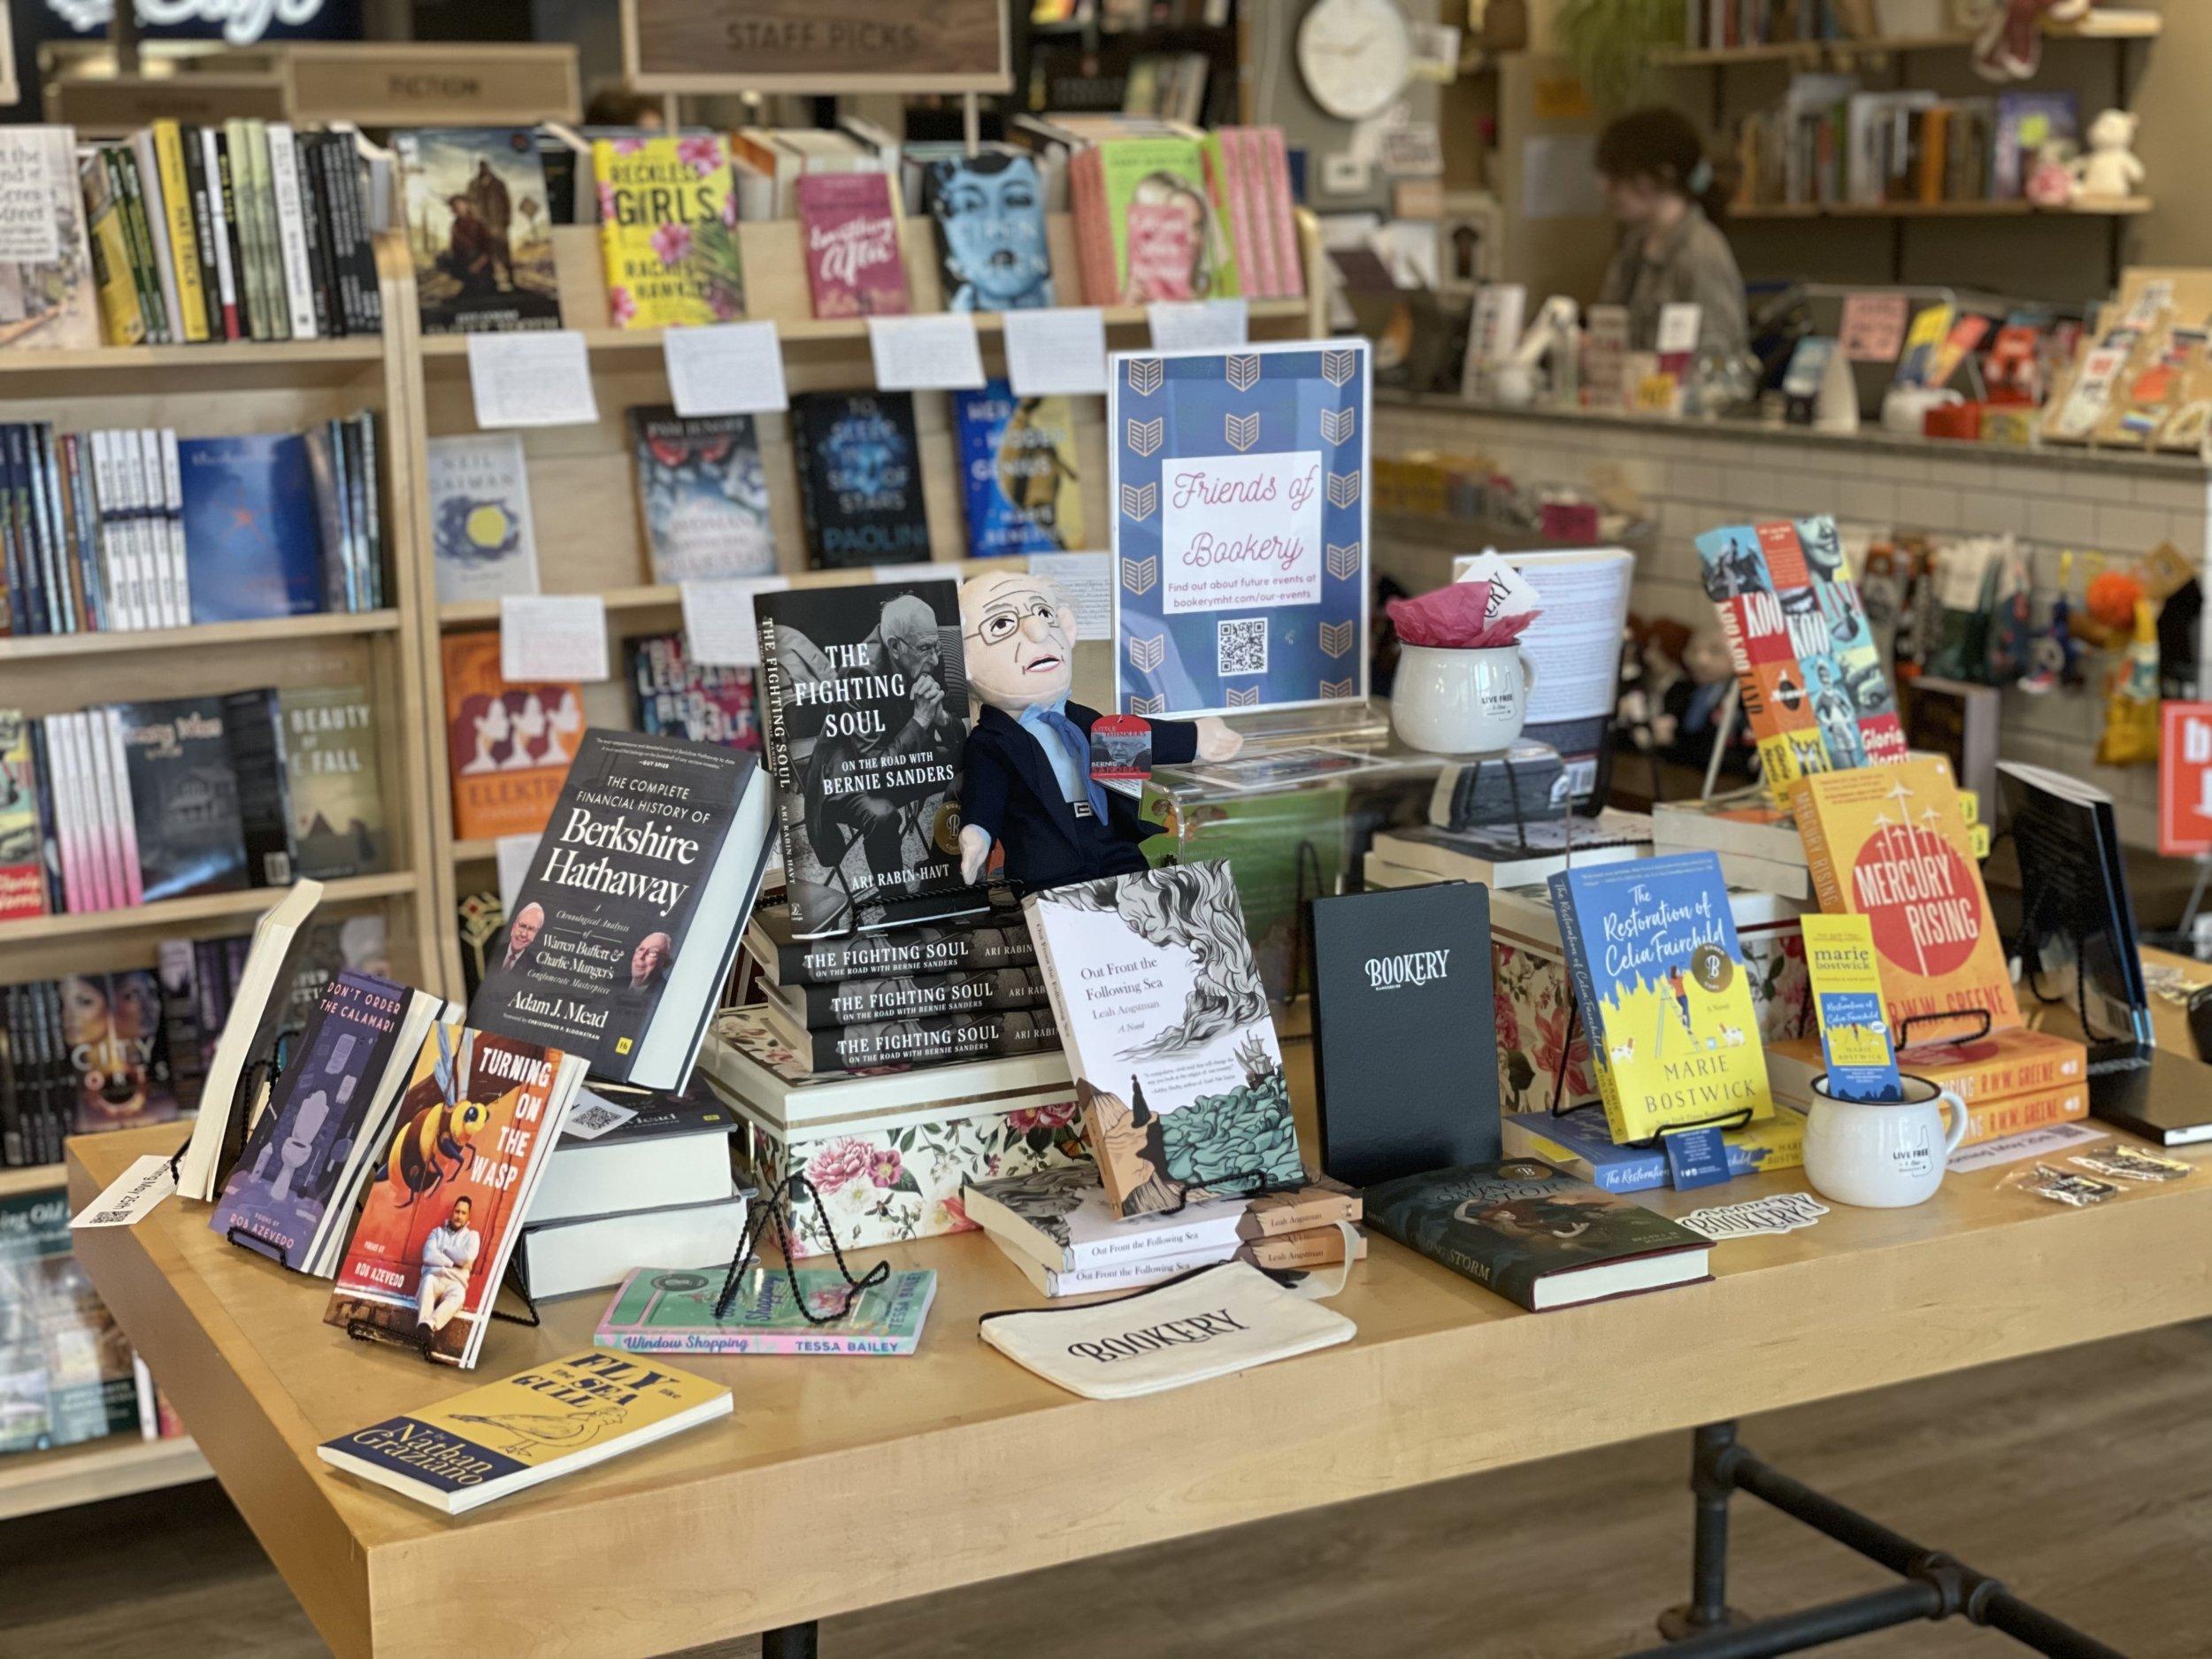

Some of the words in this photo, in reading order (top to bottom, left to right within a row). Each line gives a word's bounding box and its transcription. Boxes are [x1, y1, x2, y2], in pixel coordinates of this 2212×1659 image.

[726, 21, 816, 50] STAFF
[828, 22, 921, 51] PICKS
[614, 186, 716, 226] GIRLS
[1172, 472, 1277, 509] Friends
[1288, 464, 1319, 511] of
[1182, 532, 1304, 571] Bookery
[1168, 581, 1188, 592] Find
[1191, 580, 1207, 590] out
[1210, 579, 1239, 589] about
[1240, 577, 1270, 587] future
[1272, 575, 1303, 585] events
[1305, 574, 1317, 583] at
[1173, 592, 1311, 609] bookerymht.com/our-events
[1741, 592, 1785, 639] KOO
[762, 618, 776, 651] THE
[1785, 611, 1831, 660] KOO
[825, 643, 871, 668] THE
[768, 657, 785, 736] FIGHTING
[794, 673, 905, 706] FIGHTING
[1481, 696, 1498, 705] LIVE
[1499, 694, 1513, 703] FREE
[291, 704, 370, 733] BEAUTY
[826, 709, 887, 738] SOUL
[1862, 728, 1905, 749] Gloria
[311, 749, 362, 773] FALL
[776, 741, 790, 788] SOUL
[841, 759, 856, 772] ON
[858, 757, 878, 770] THE
[880, 754, 907, 768] ROAD
[909, 751, 933, 764] WITH
[607, 775, 626, 789] THE
[629, 779, 690, 800] COMPLETE
[823, 772, 881, 795] BERNIE
[886, 764, 955, 787] SANDERS
[576, 790, 634, 810] FINANCIAL
[637, 800, 689, 819] HISTORY
[691, 810, 710, 824] OF
[559, 807, 699, 864] Berkshire
[1794, 790, 1825, 854] MERCURY
[1814, 856, 1839, 906] RISING
[539, 849, 689, 917] Hathaway
[851, 874, 874, 890] ARI
[878, 864, 950, 887] RABIN-HAVT
[1854, 854, 1954, 908] MERCURY
[1628, 884, 1652, 905] The
[556, 910, 600, 926] Chronological
[601, 918, 630, 932] Analysis
[1603, 900, 1694, 941] Restoration
[1695, 891, 1712, 918] of
[1905, 897, 1979, 947] RISING
[543, 934, 575, 953] Warren
[576, 941, 608, 961] Buffett
[610, 949, 625, 963] &
[582, 930, 591, 939] of
[1605, 944, 1655, 977] Celia
[1650, 918, 1726, 963] Fairchild
[536, 950, 569, 971] Charlie
[569, 958, 615, 979] Munger's
[804, 951, 836, 969] THE
[842, 944, 920, 965] FIGHTING
[926, 941, 969, 958] SOUL
[985, 948, 1002, 956] ARI
[1814, 946, 1870, 961] marie
[1815, 959, 1870, 970] bostwick
[526, 969, 571, 987] Conglomerate
[572, 978, 611, 995] Masterpiece
[815, 969, 827, 978] ON
[829, 967, 845, 976] THE
[847, 965, 868, 975] ROAD
[871, 964, 890, 973] WITH
[893, 962, 921, 972] BERNIE
[923, 958, 958, 969] SANDERS
[1080, 967, 1105, 979] Out
[1106, 960, 1138, 975] Front
[1140, 956, 1158, 968] the
[1364, 949, 1450, 987] BOOKERY
[326, 982, 362, 1002] DON'T
[365, 994, 402, 1015] ORDER
[832, 994, 864, 1011] THE
[870, 987, 946, 1009] FIGHTING
[951, 982, 994, 999] SOUL
[1086, 981, 1142, 1001] Following
[1143, 977, 1164, 990] Sea
[1946, 985, 2008, 1020] GREENE
[319, 999, 339, 1014] THE
[341, 1006, 396, 1033] CALAMARI
[508, 990, 550, 1016] Adam
[549, 1000, 561, 1017] J.
[563, 1002, 609, 1028] Mead
[856, 1011, 872, 1020] THE
[873, 1009, 895, 1018] ROAD
[896, 1007, 917, 1017] WITH
[918, 1003, 947, 1014] BERNIE
[949, 1000, 983, 1010] SANDERS
[1092, 1008, 1116, 1019] Leah
[1118, 1001, 1160, 1015] Angstman
[527, 1018, 560, 1032] CHRISTOPHER
[565, 1027, 600, 1041] BLOOMSTRAN
[837, 1036, 870, 1054] THE
[875, 1031, 951, 1051] FIGHTING
[956, 1025, 999, 1042] SOUL
[1125, 1021, 1145, 1031] Novel
[71, 1036, 156, 1071] CITY
[479, 1048, 553, 1087] TURNING
[1663, 1054, 1730, 1081] MARIE
[2017, 1062, 2055, 1087] GREENE
[515, 1093, 542, 1123] ON
[1644, 1079, 1756, 1113] BOSTWICK
[496, 1125, 531, 1158] THE
[1893, 1150, 1911, 1161] LIVE
[1911, 1148, 1930, 1157] FREE
[471, 1156, 519, 1191] WASP
[1603, 1169, 1620, 1187] The
[1622, 1164, 1670, 1184] Restoration
[229, 1213, 250, 1229] ROB
[251, 1223, 295, 1249] AZEVEDO
[1271, 1218, 1288, 1227] Leah
[1290, 1213, 1322, 1224] Angstman
[1682, 1205, 1813, 1234] BOOKERY
[1091, 1245, 1110, 1256] Out
[1110, 1242, 1131, 1254] Front
[1132, 1240, 1145, 1252] the
[1147, 1233, 1184, 1249] Following
[1185, 1230, 1199, 1240] Sea
[355, 1262, 370, 1279] ROB
[370, 1267, 405, 1288] AZEVEDO
[1075, 1271, 1093, 1281] Out
[1095, 1268, 1116, 1279] Front
[1118, 1265, 1132, 1277] the
[1134, 1261, 1173, 1276] Following
[1175, 1260, 1191, 1271] Sea
[1449, 1248, 1492, 1282] STORM
[623, 1335, 683, 1351] Window
[685, 1334, 749, 1353] Shopping
[795, 1340, 841, 1352] TESSA
[847, 1340, 899, 1353] BAILEY
[1067, 1309, 1250, 1363] BOOKERY
[563, 1352, 682, 1391] FLY
[659, 1387, 683, 1400] like
[511, 1373, 601, 1409] GULL
[571, 1377, 641, 1407] SEA
[353, 1427, 484, 1486] Graziano
[396, 1423, 494, 1475] Nathan
